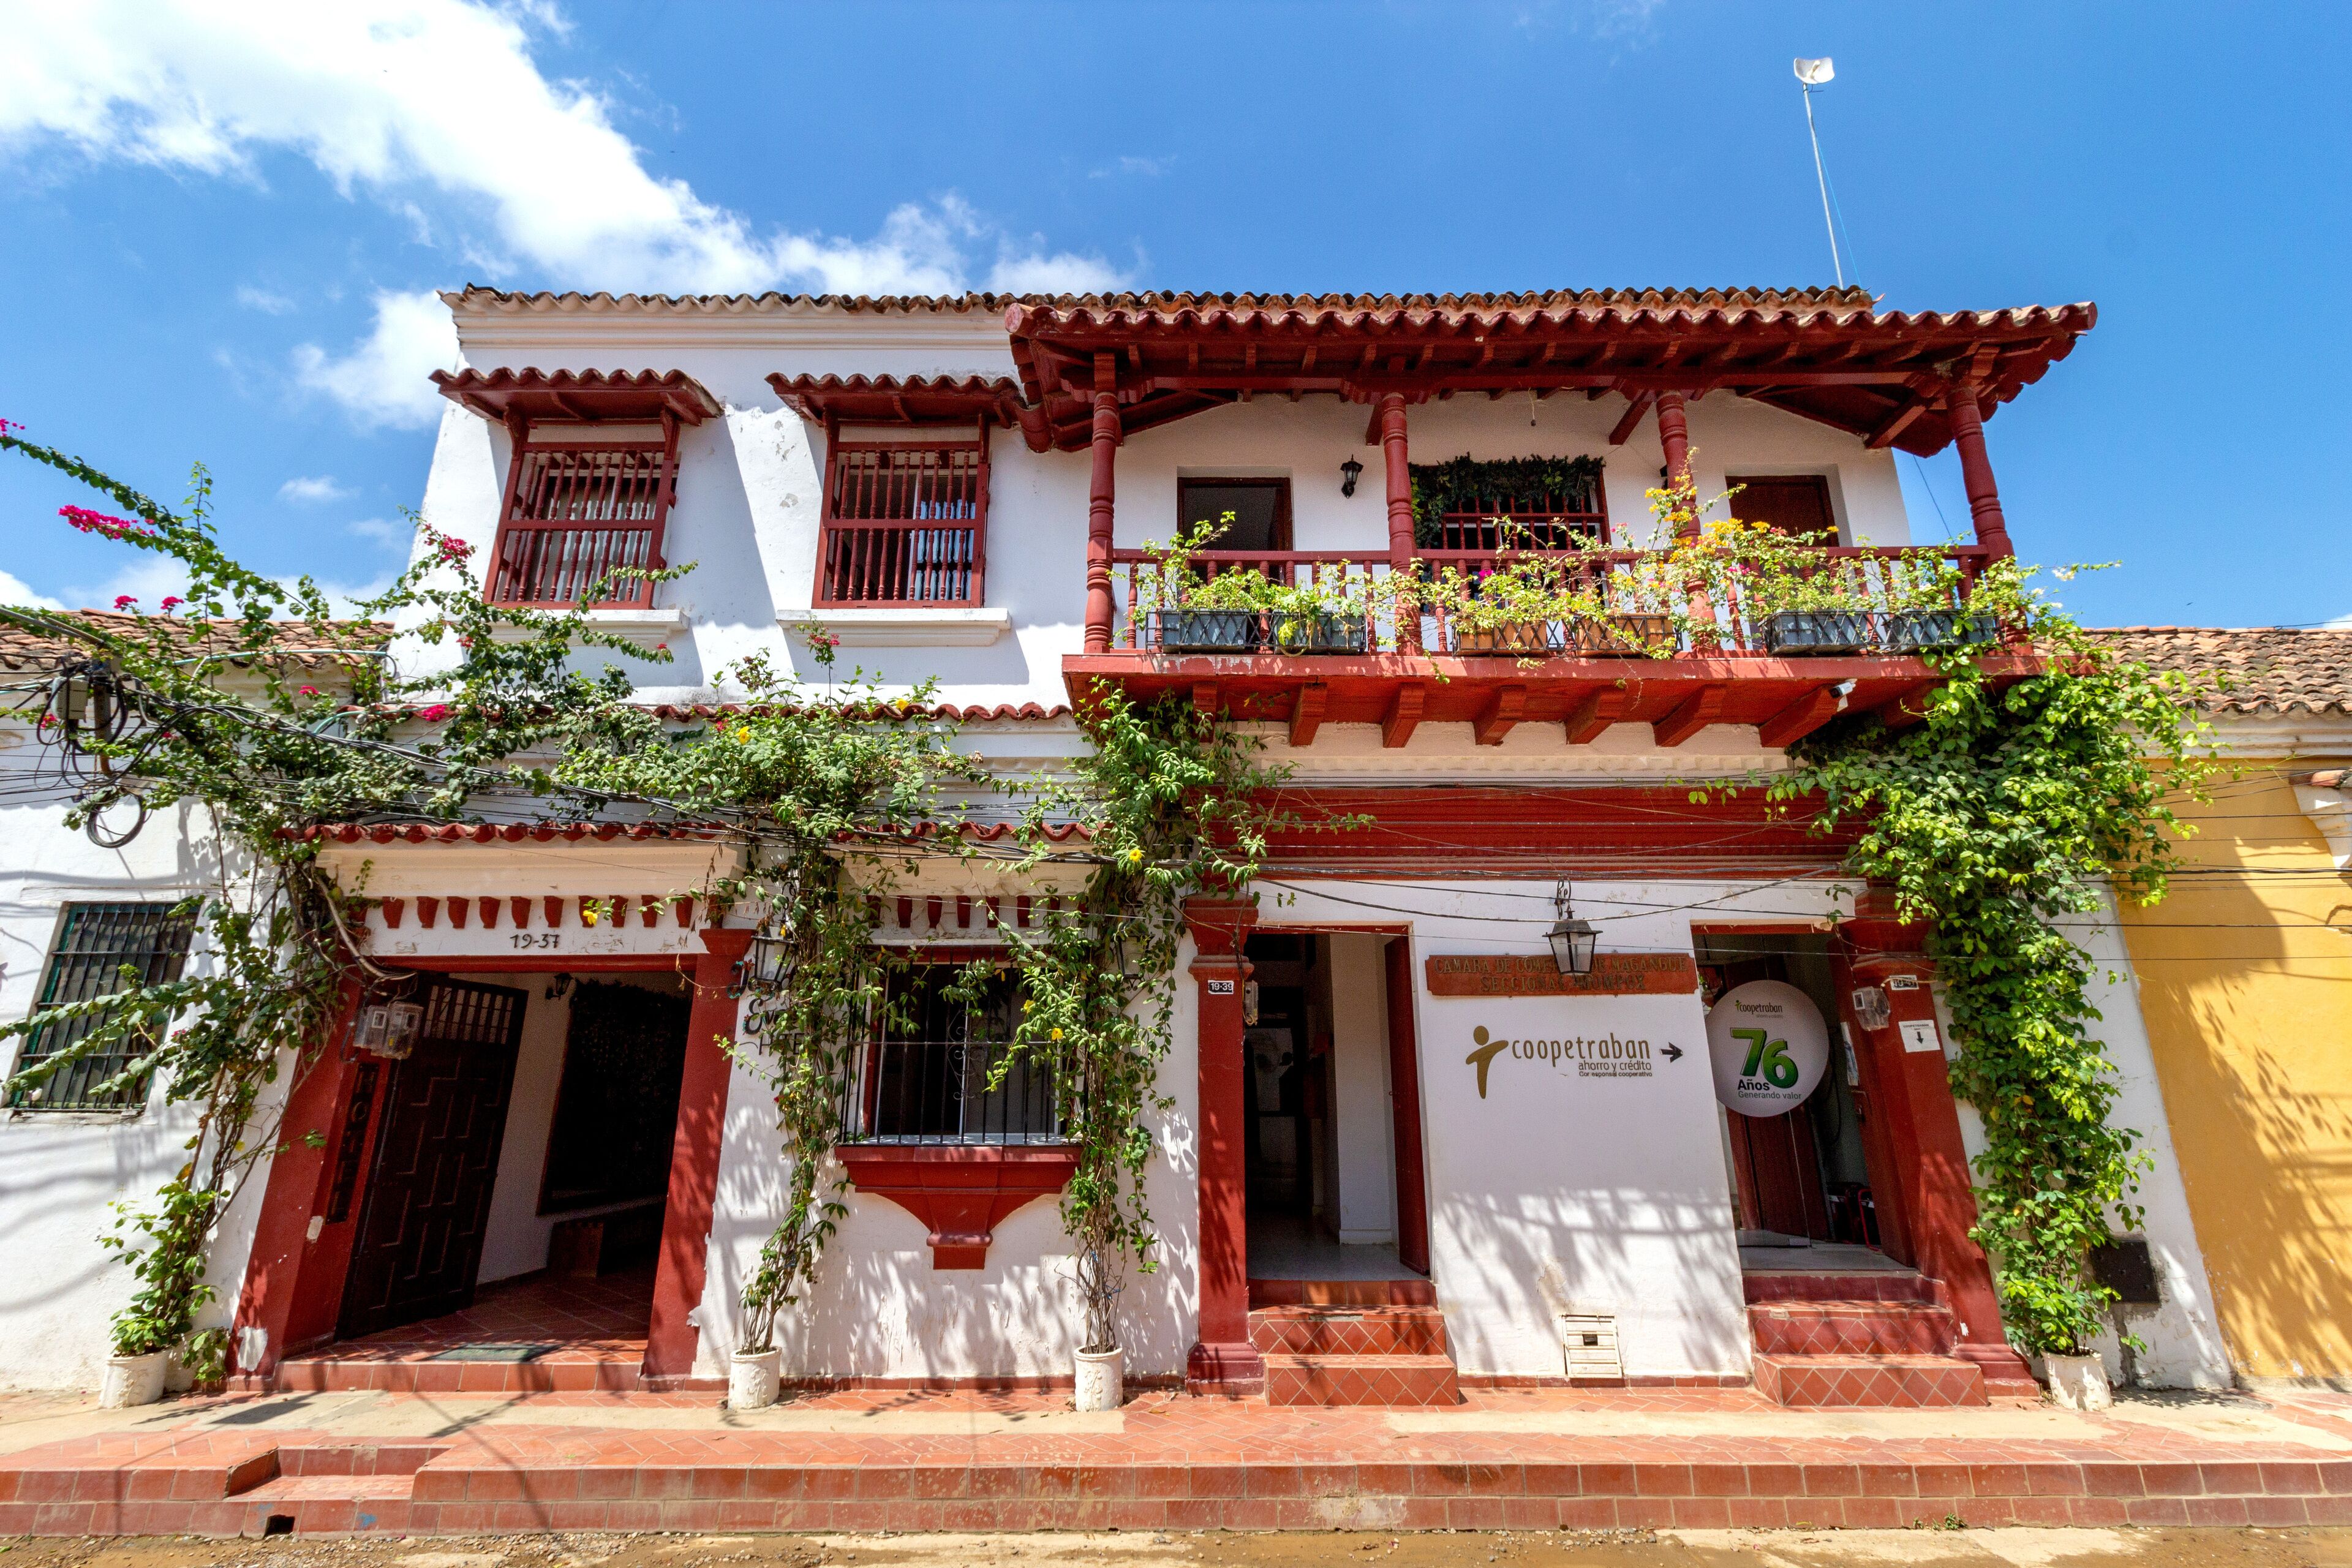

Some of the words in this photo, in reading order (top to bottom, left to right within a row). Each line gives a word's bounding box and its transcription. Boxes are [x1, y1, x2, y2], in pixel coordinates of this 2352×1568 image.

[510, 933, 560, 949] 19-37
[1434, 957, 1491, 973] CAMARA
[1495, 957, 1512, 973] DE
[1480, 974, 1567, 992] SECCIONAL
[1740, 1001, 1783, 1014] coopetraban
[1512, 1032, 1651, 1068] coopetraban
[1730, 1027, 1799, 1089] 76
[1578, 1060, 1610, 1071] ahorro
[1611, 1062, 1617, 1072] y
[1619, 1060, 1652, 1071] crédito
[1737, 1079, 1770, 1091] Años
